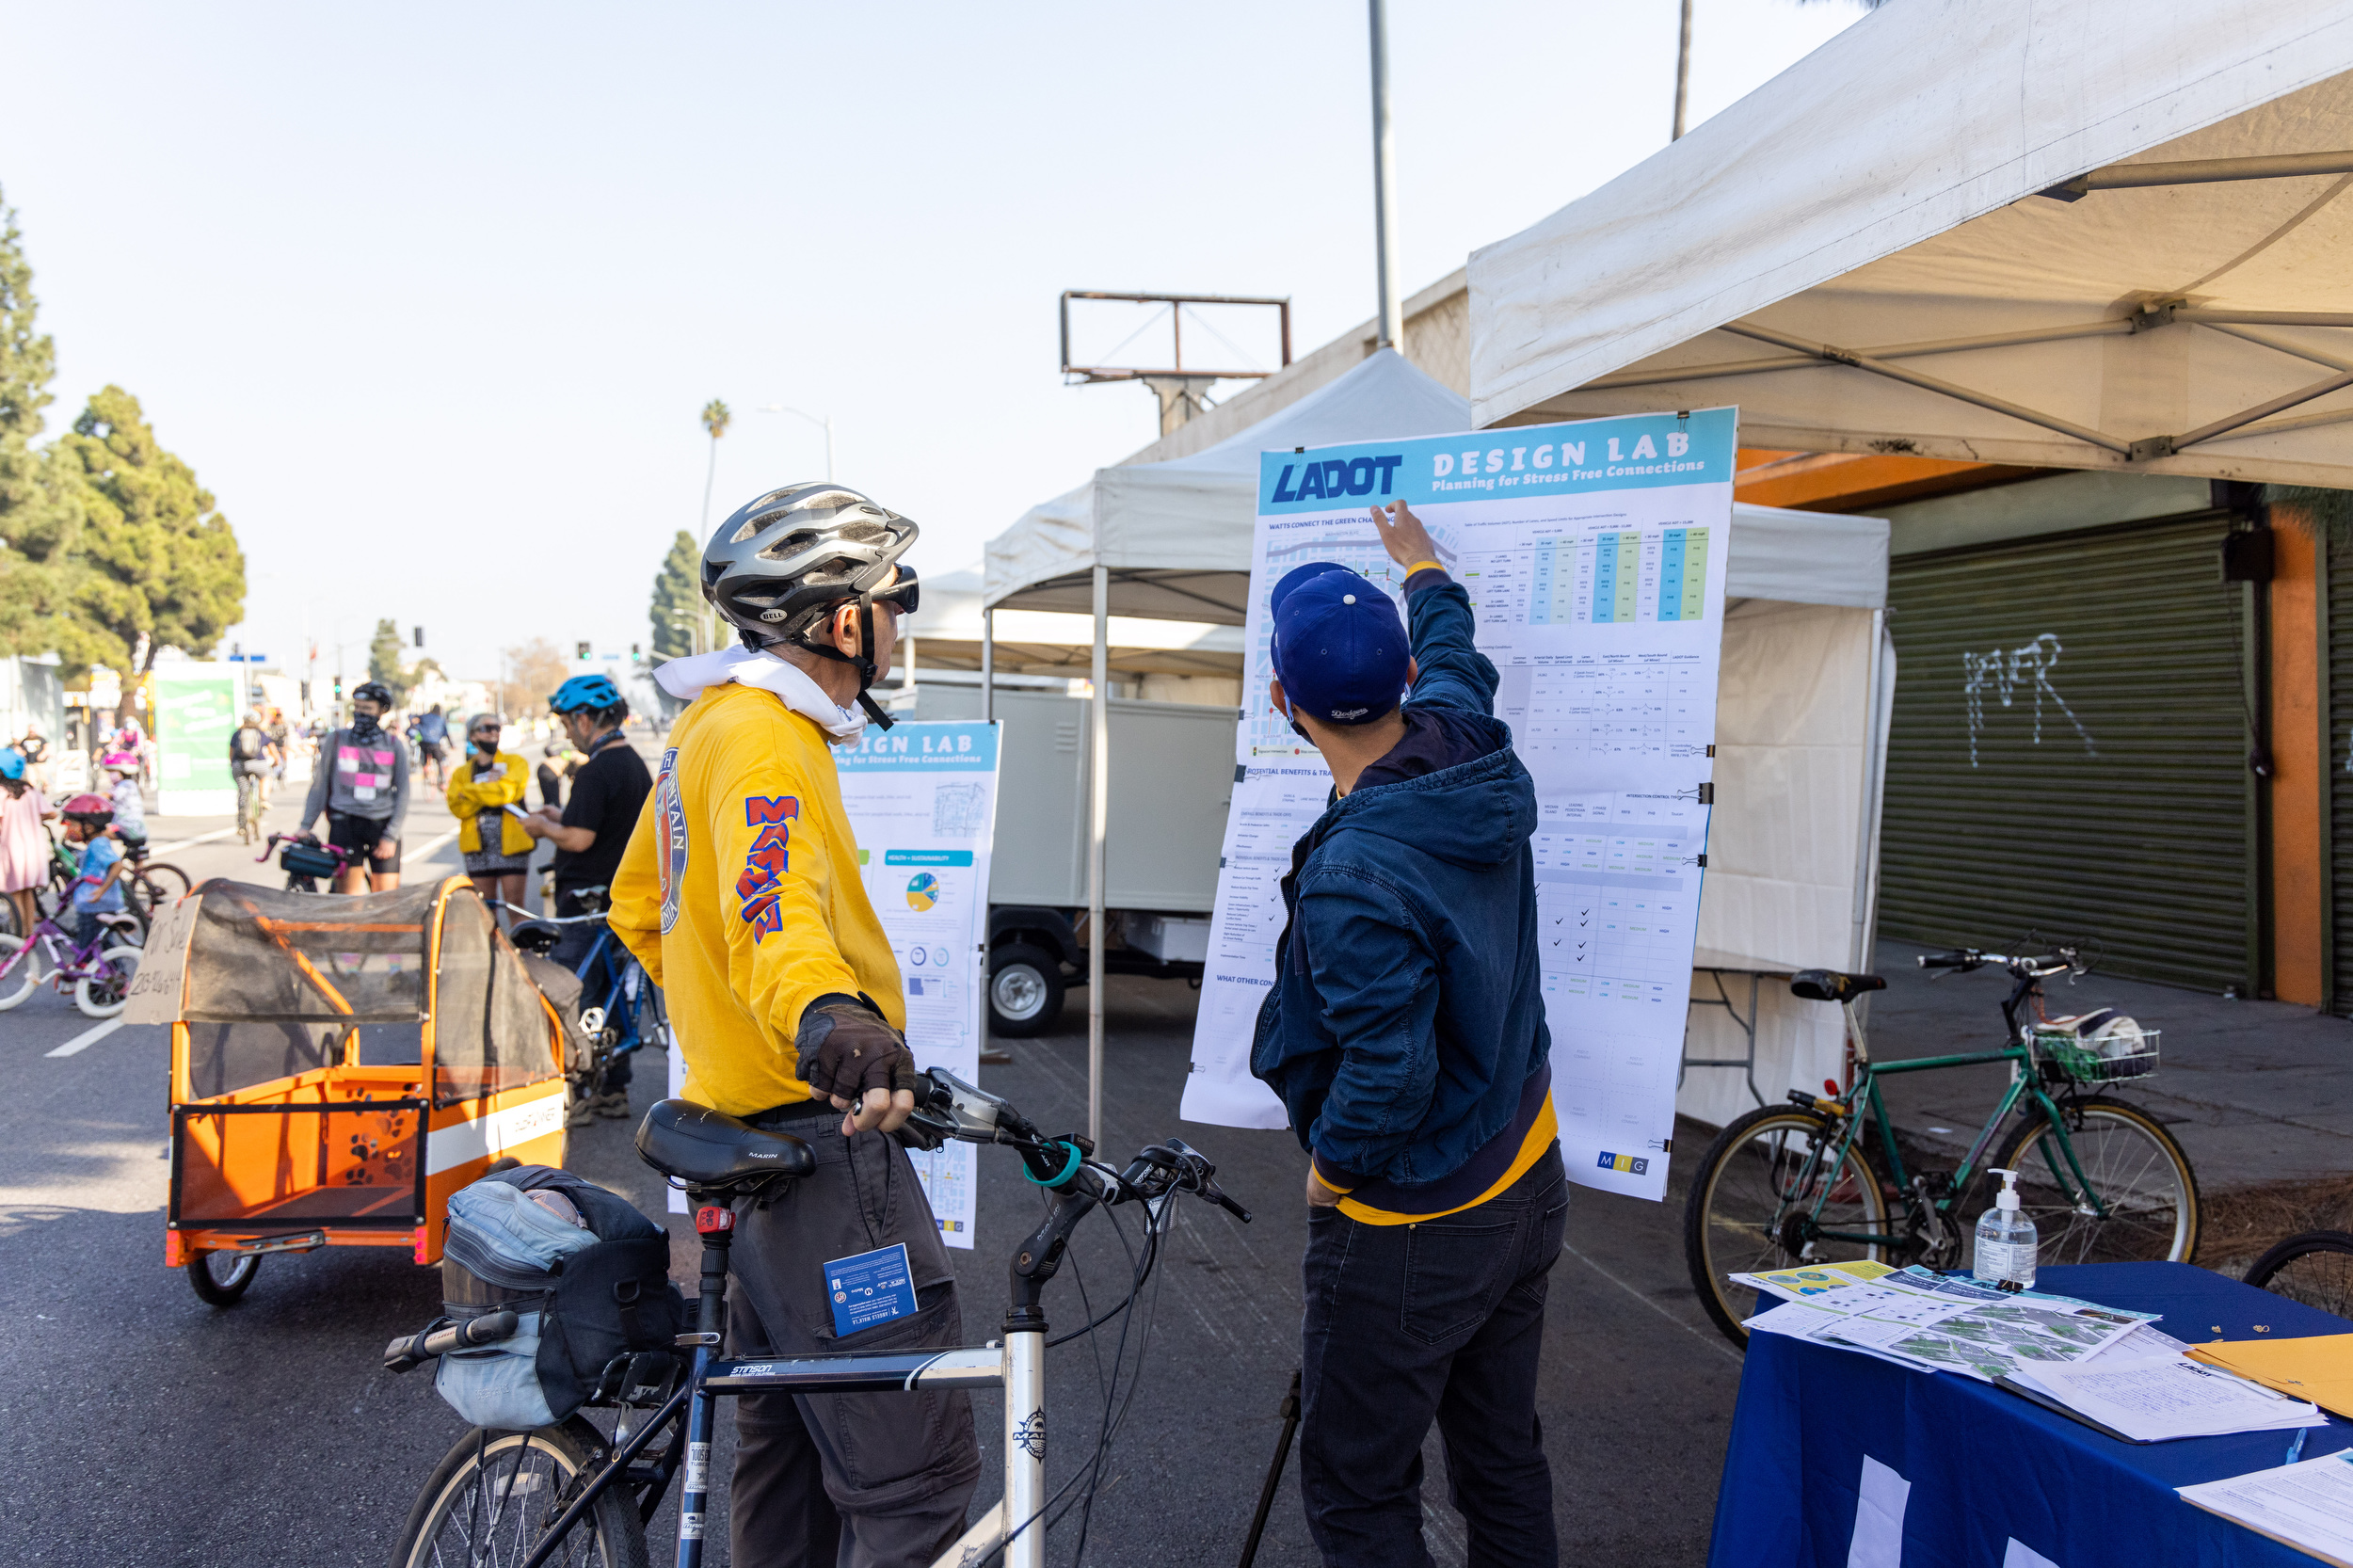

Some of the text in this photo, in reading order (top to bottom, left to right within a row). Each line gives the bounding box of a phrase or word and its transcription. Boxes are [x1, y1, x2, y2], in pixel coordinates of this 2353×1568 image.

[1433, 433, 1690, 476] DESIGN LAB
[1272, 456, 1402, 503] LADOT
[1432, 461, 1705, 491] Planning for Stress Free Connections
[1291, 520, 1320, 529] CONNECT
[922, 735, 972, 754] LAB
[853, 755, 867, 764] for
[868, 755, 897, 763] Stress
[899, 755, 920, 763] Free
[921, 754, 982, 763] Connections
[1236, 976, 1259, 985] OTHER
[1601, 1155, 1643, 1172] MIG
[872, 1311, 888, 1320] ANGELS
[731, 1365, 773, 1374] STINSON
